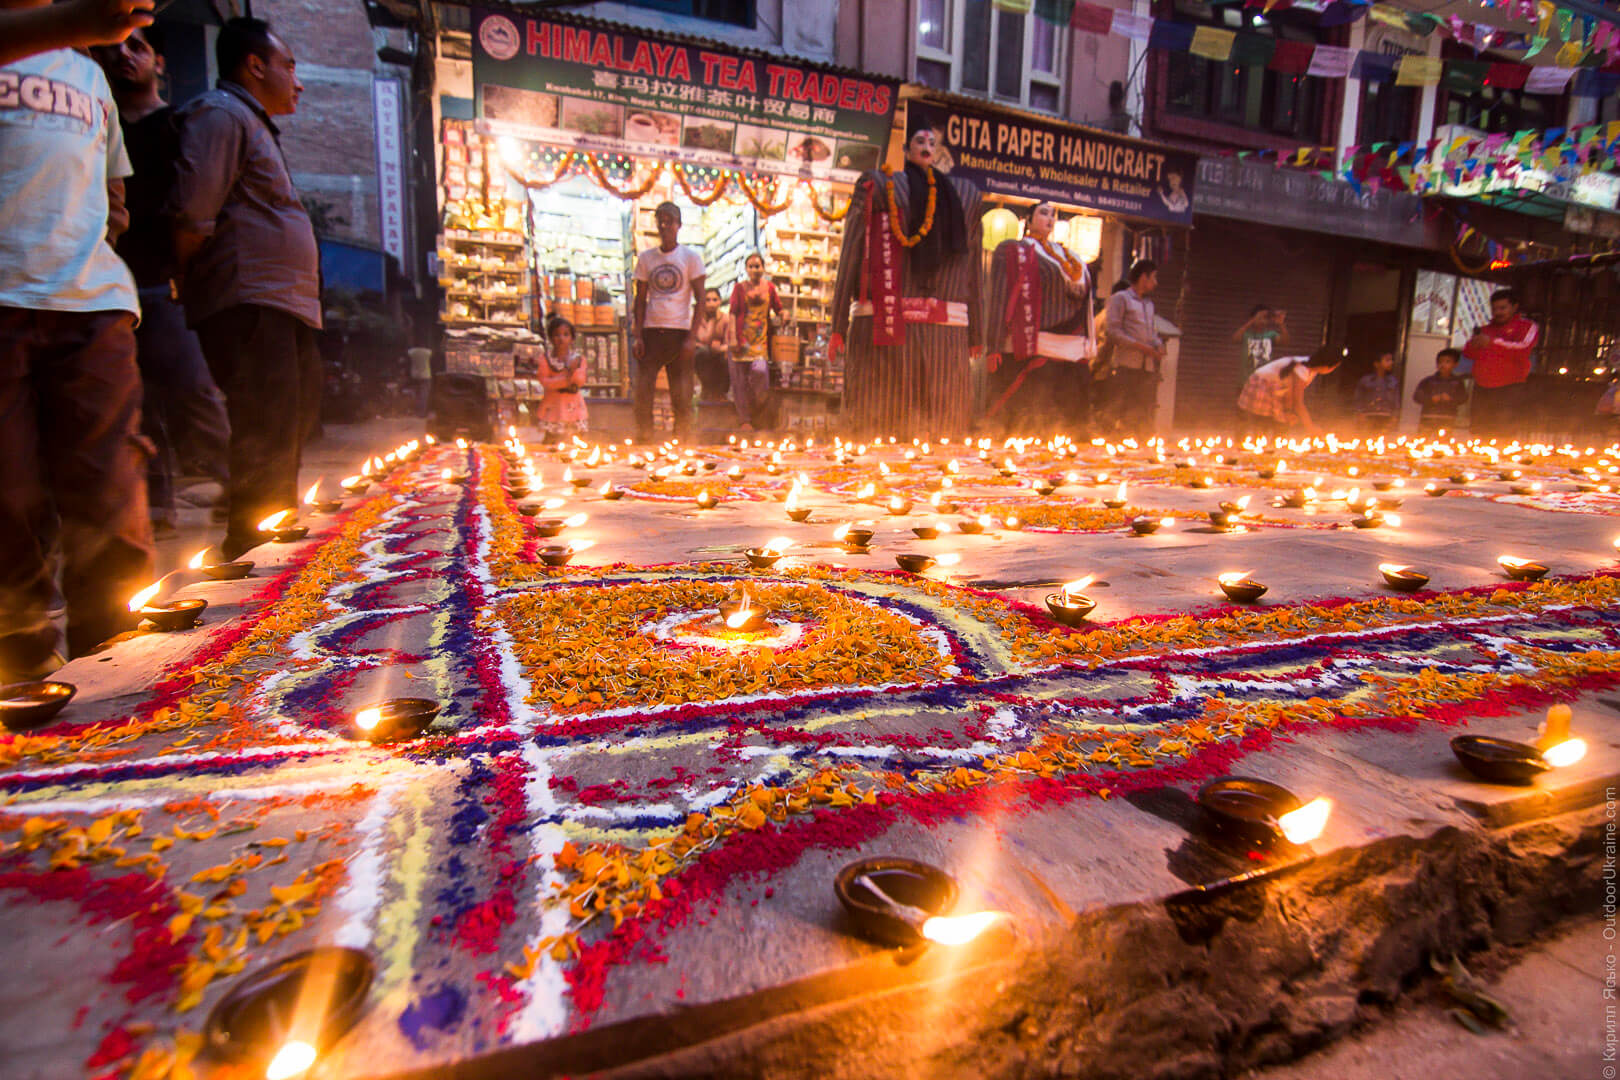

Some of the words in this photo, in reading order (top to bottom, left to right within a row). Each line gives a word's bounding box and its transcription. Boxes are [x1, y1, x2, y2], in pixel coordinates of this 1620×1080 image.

[526, 19, 691, 82] HIMALAYA
[699, 50, 757, 93] TEA
[766, 63, 891, 117] TRADERS
[947, 114, 992, 151] GITA
[997, 123, 1055, 162] PAPER
[1059, 135, 1165, 182] HANDICRAFT
[960, 153, 1036, 178] Manufacture,
[1039, 165, 1099, 189] Wholesaler
[1101, 177, 1109, 189] &
[1112, 179, 1153, 198] Retailer
